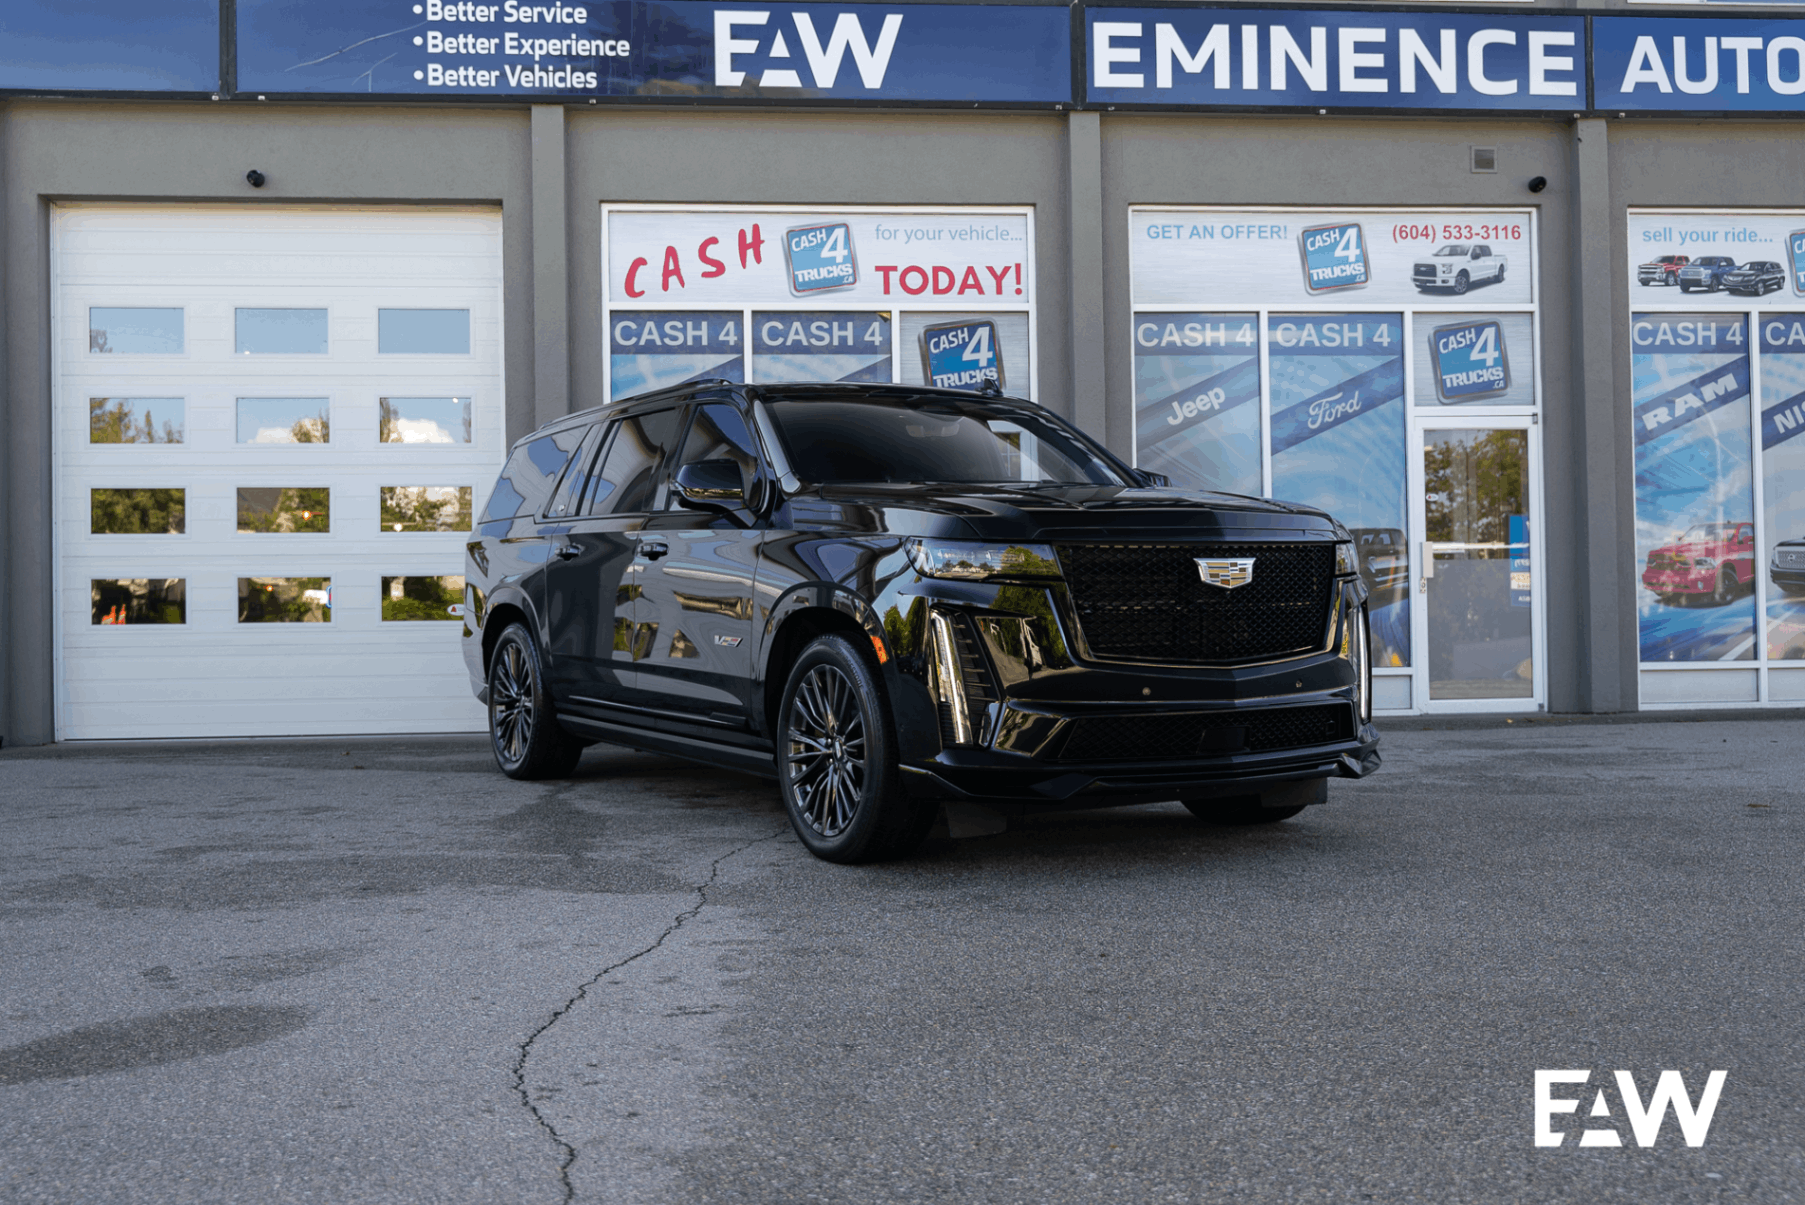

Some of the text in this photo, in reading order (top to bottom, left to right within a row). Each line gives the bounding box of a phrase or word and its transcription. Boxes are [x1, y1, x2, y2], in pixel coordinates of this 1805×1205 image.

[427, 0, 588, 24] Better Service
[427, 31, 630, 61] Better Experience
[1093, 22, 1805, 96] EMINENCE AUTO
[427, 63, 598, 88] Better Vehicles
[875, 224, 1022, 244] for your vehicle...
[1146, 225, 1287, 239] GET AN OFFER!
[1307, 227, 1361, 262] CASH 4
[1392, 224, 1521, 243] (604) 533-3116
[1642, 227, 1773, 246] sell your ride...
[791, 227, 848, 263] CASH 4
[624, 223, 765, 298] CASH
[795, 263, 853, 282] TRUCKS
[1309, 262, 1365, 281] TRUCKS
[875, 263, 1023, 295] TODAY!
[614, 321, 738, 346] CASH 4
[761, 321, 883, 346] CASH 4
[1137, 323, 1254, 347] CASH 4
[1276, 323, 1391, 347] CASH 4
[1633, 322, 1743, 346] CASH 4
[929, 326, 993, 367] CASH 4
[1439, 326, 1499, 367] CASH 4
[932, 367, 998, 388] TRUCKS
[1442, 367, 1504, 388] TRUCKS
[1166, 387, 1226, 426] Jeep
[1307, 391, 1362, 430] Ford
[1641, 373, 1738, 431] RAM
